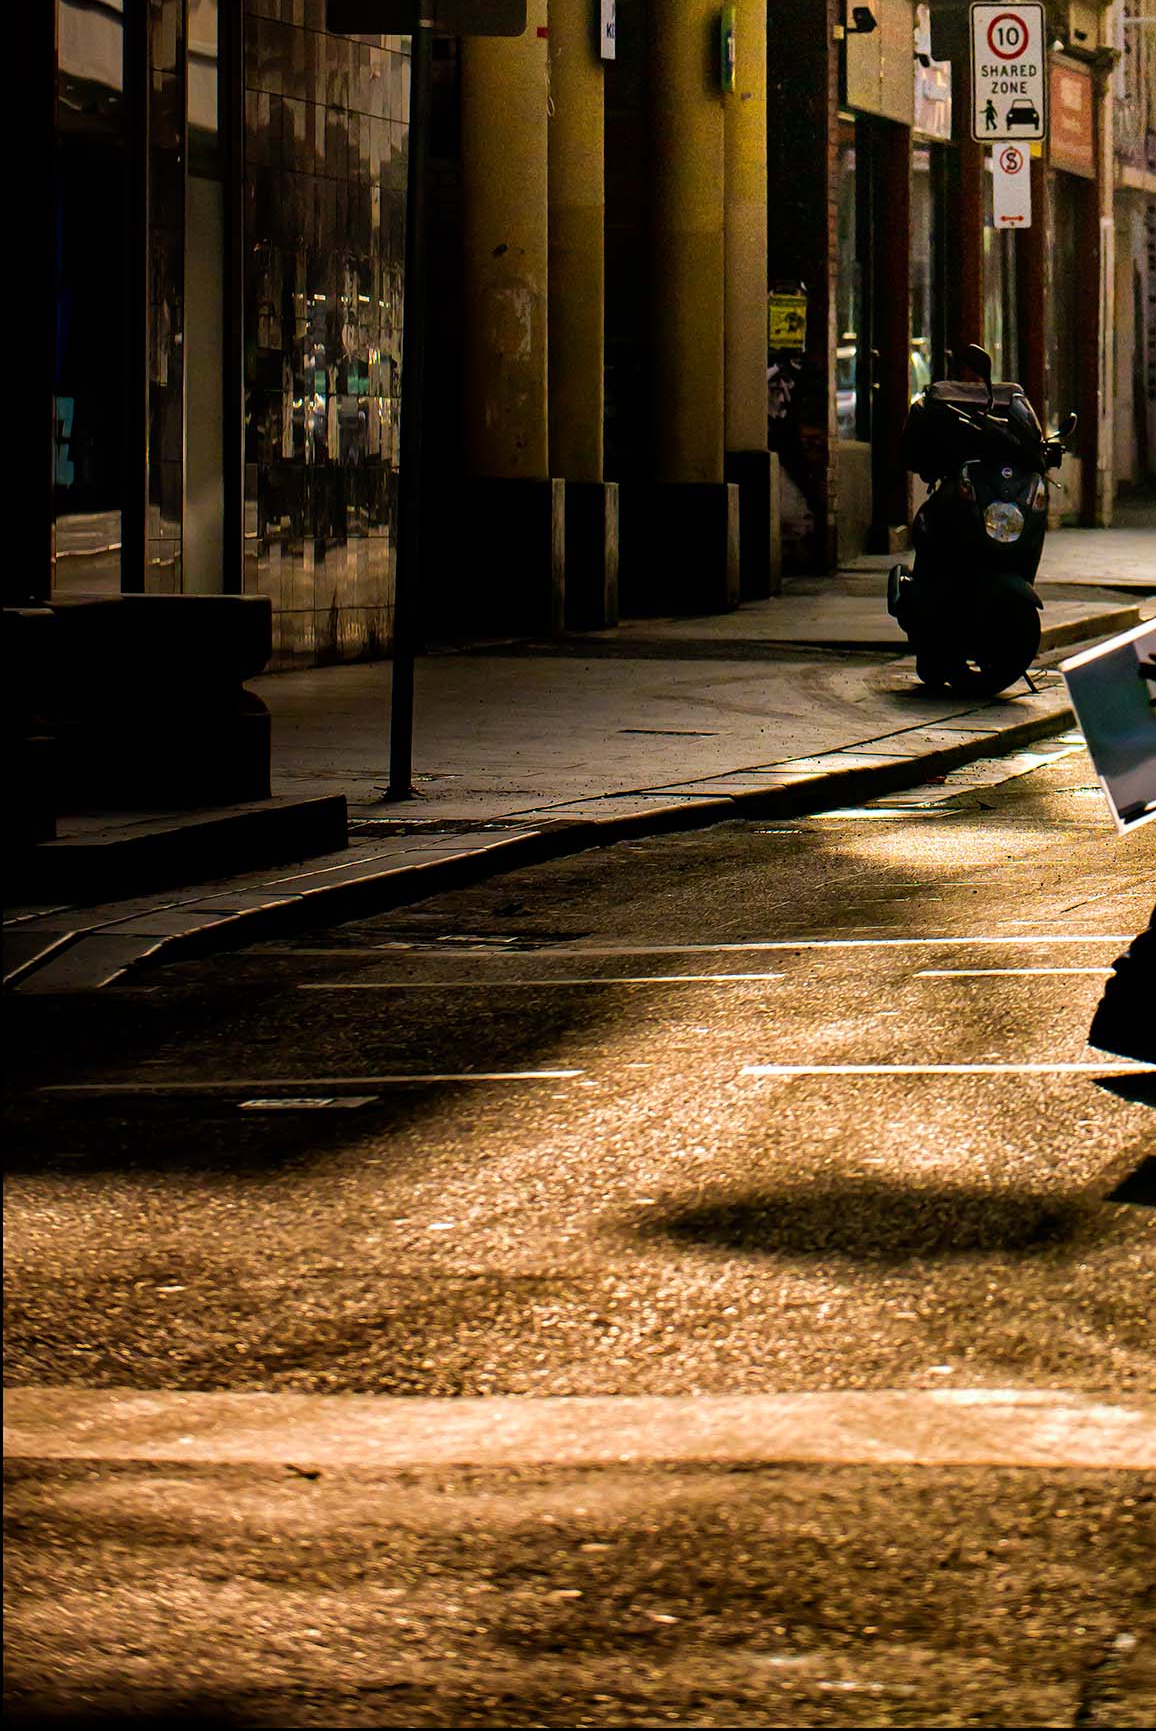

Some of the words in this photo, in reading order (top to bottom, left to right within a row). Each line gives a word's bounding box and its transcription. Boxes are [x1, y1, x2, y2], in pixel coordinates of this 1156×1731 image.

[997, 27, 1020, 46] 10
[981, 64, 1038, 78] SHARED
[991, 81, 1028, 95] ZONE
